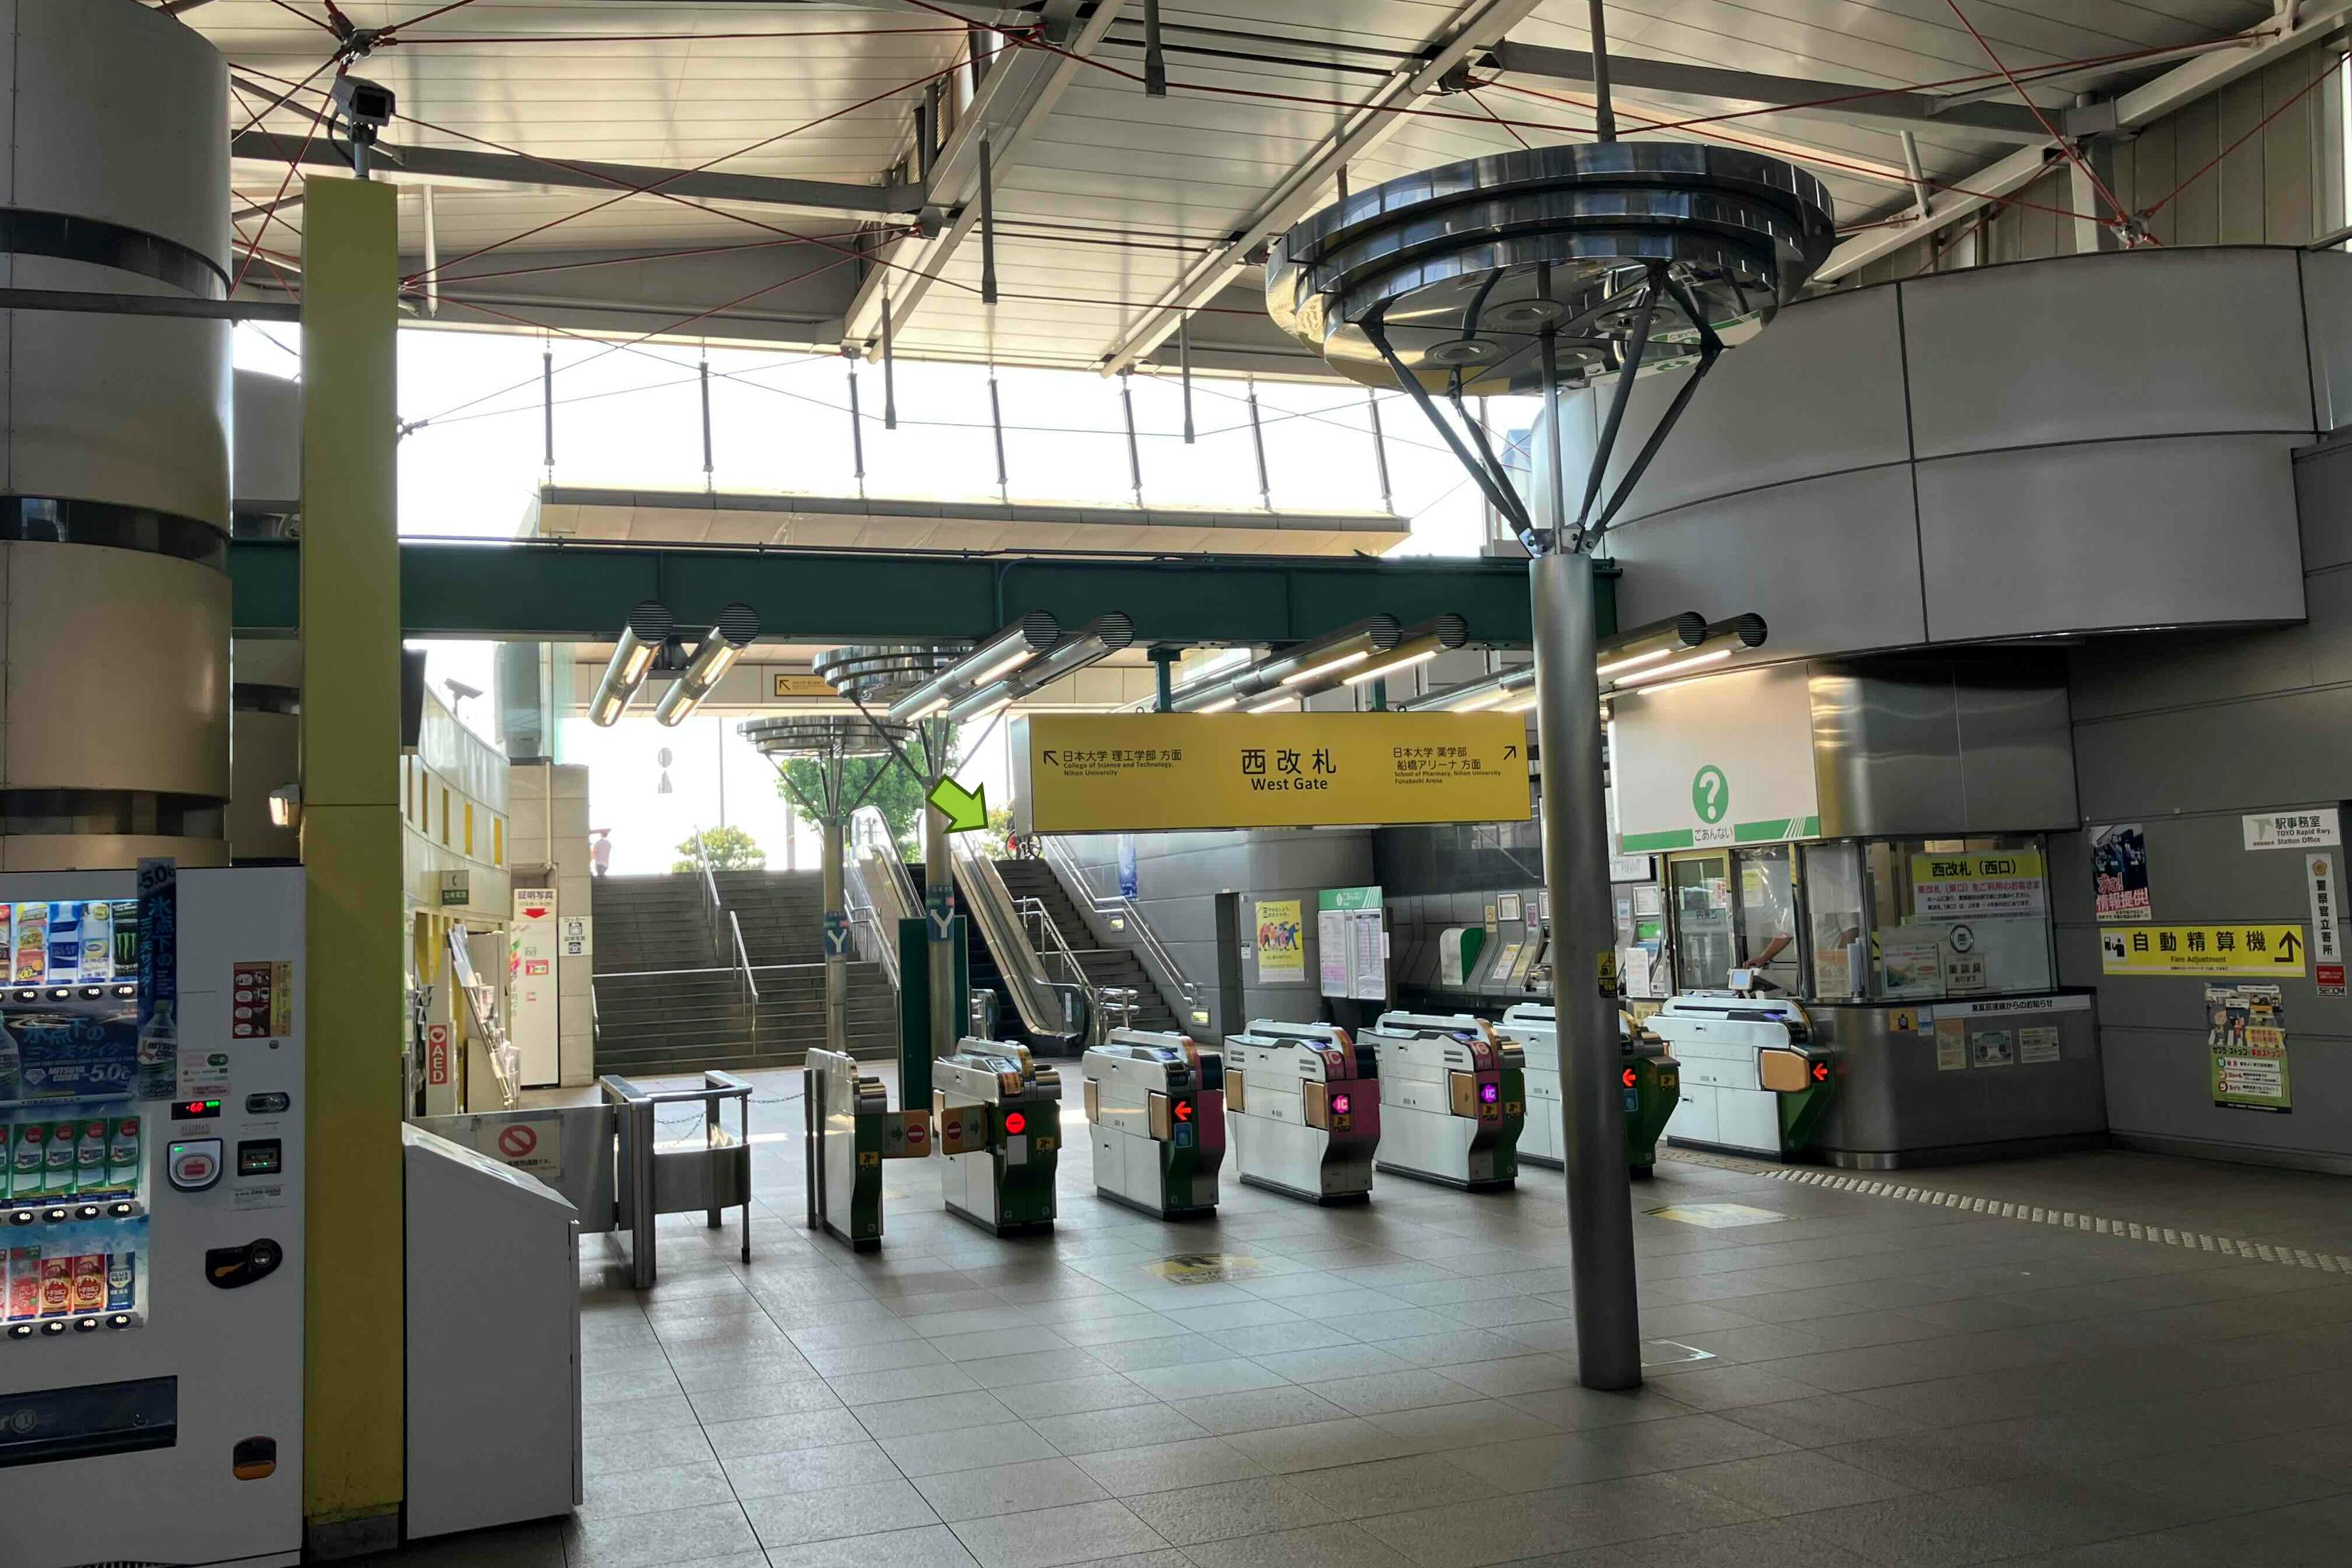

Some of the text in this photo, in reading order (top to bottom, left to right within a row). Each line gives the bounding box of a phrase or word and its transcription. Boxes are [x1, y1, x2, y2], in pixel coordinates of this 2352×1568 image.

[1063, 749, 1182, 761] 日本大学 理工学部 方面
[1393, 746, 1467, 758] 日本大学 薬学部
[1241, 748, 1336, 775] 西改札
[1397, 758, 1481, 770] 船橋アリーナ 方面
[1251, 778, 1328, 790] West Gate
[2275, 816, 2321, 830] 駅事務室
[1694, 827, 1733, 842] ごあんない
[2132, 930, 2266, 952] 自動精算機
[2187, 956, 2227, 964] Adjustment
[432, 1044, 445, 1083] AED
[1337, 1097, 1348, 1110] IC
